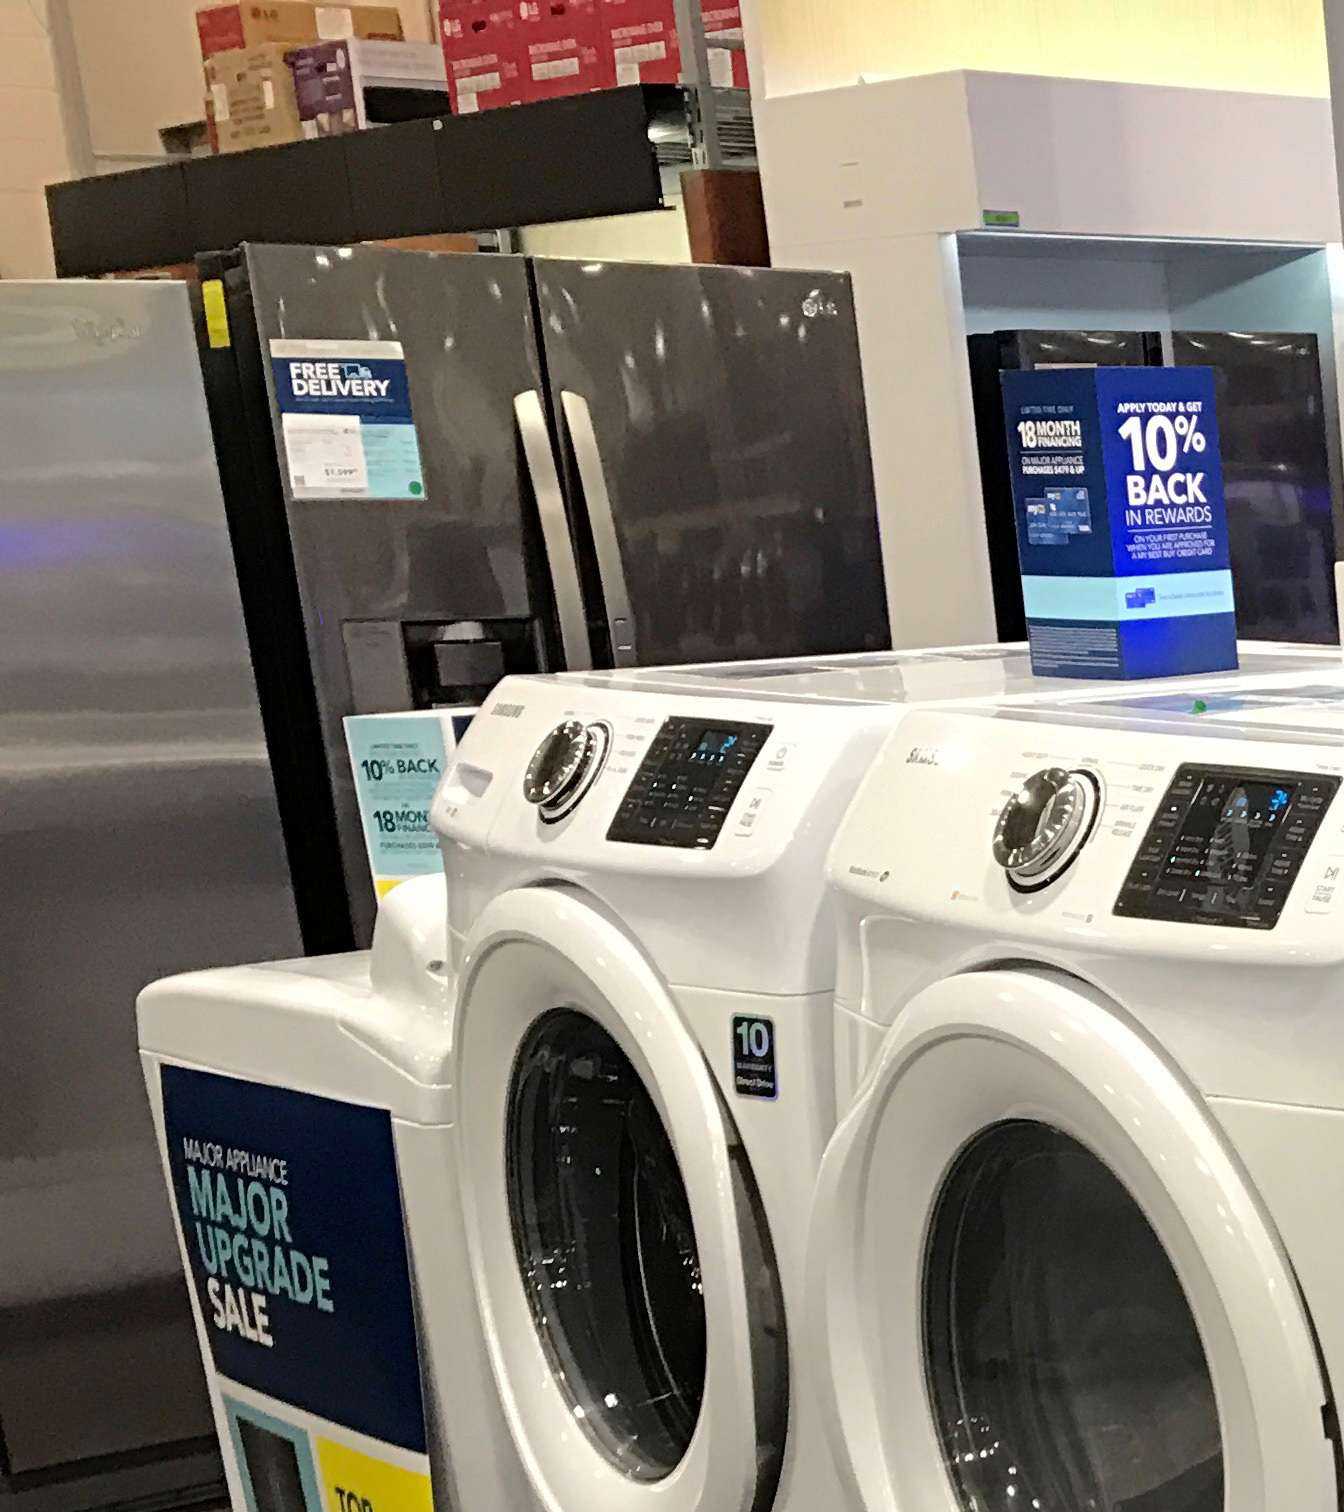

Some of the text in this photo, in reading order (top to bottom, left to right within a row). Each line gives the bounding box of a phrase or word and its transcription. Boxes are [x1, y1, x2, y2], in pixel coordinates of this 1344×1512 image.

[289, 362, 341, 379] FREE
[292, 379, 390, 397] DELIVERY
[1117, 401, 1203, 414] APPLY TODAY & GET
[1017, 420, 1081, 448] 18 MONTH
[1117, 414, 1206, 471] 10%
[1125, 472, 1208, 506] BACK
[1125, 506, 1213, 526] IN REWARDS
[361, 759, 441, 781] 10% BACK
[373, 810, 429, 832] 18 MON
[736, 1021, 770, 1057] 10
[183, 1137, 289, 1185] MAJOR APPLIANCE
[187, 1164, 293, 1244] MAJOR
[195, 1222, 335, 1313] UPGRADE
[207, 1277, 274, 1348] SALE
